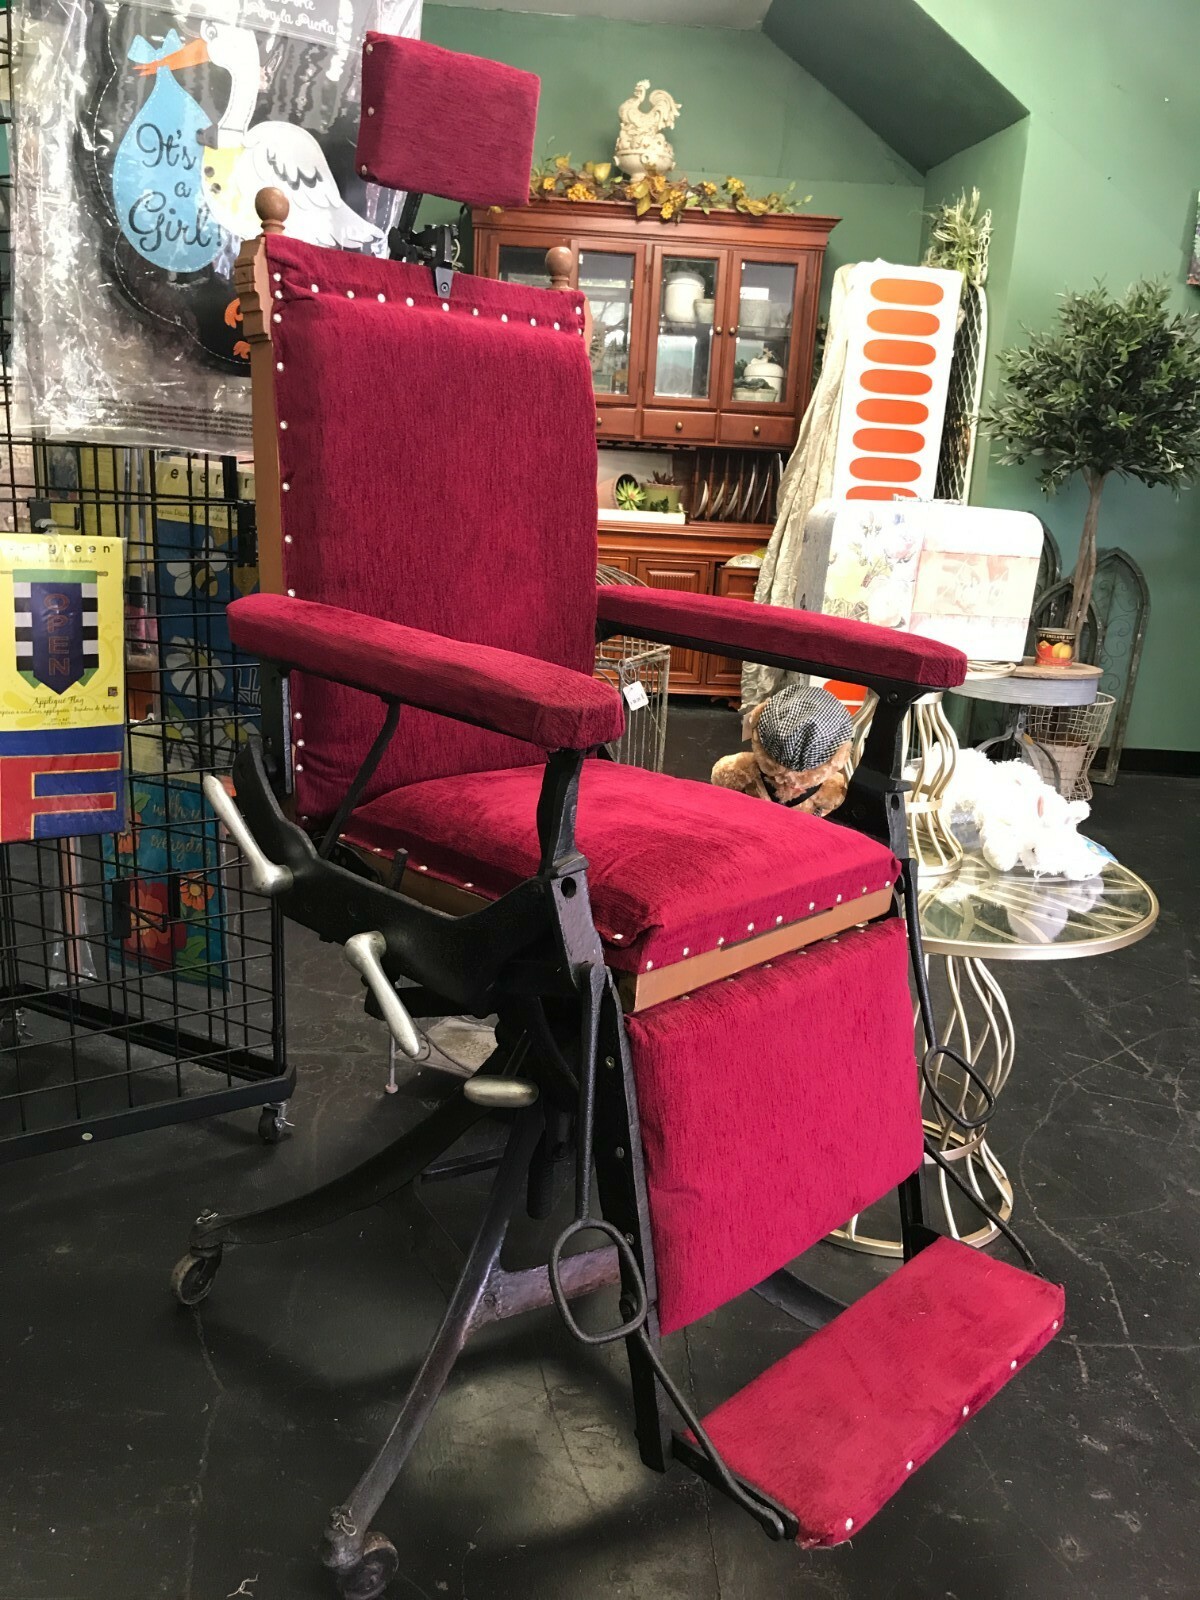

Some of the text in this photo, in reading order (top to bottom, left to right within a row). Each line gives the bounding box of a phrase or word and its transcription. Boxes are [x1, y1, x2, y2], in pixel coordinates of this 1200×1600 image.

[295, 12, 336, 36] Puerta
[136, 122, 197, 171] It's
[174, 181, 192, 198] a
[128, 191, 222, 252] Girl!
[43, 593, 70, 677] OPEN
